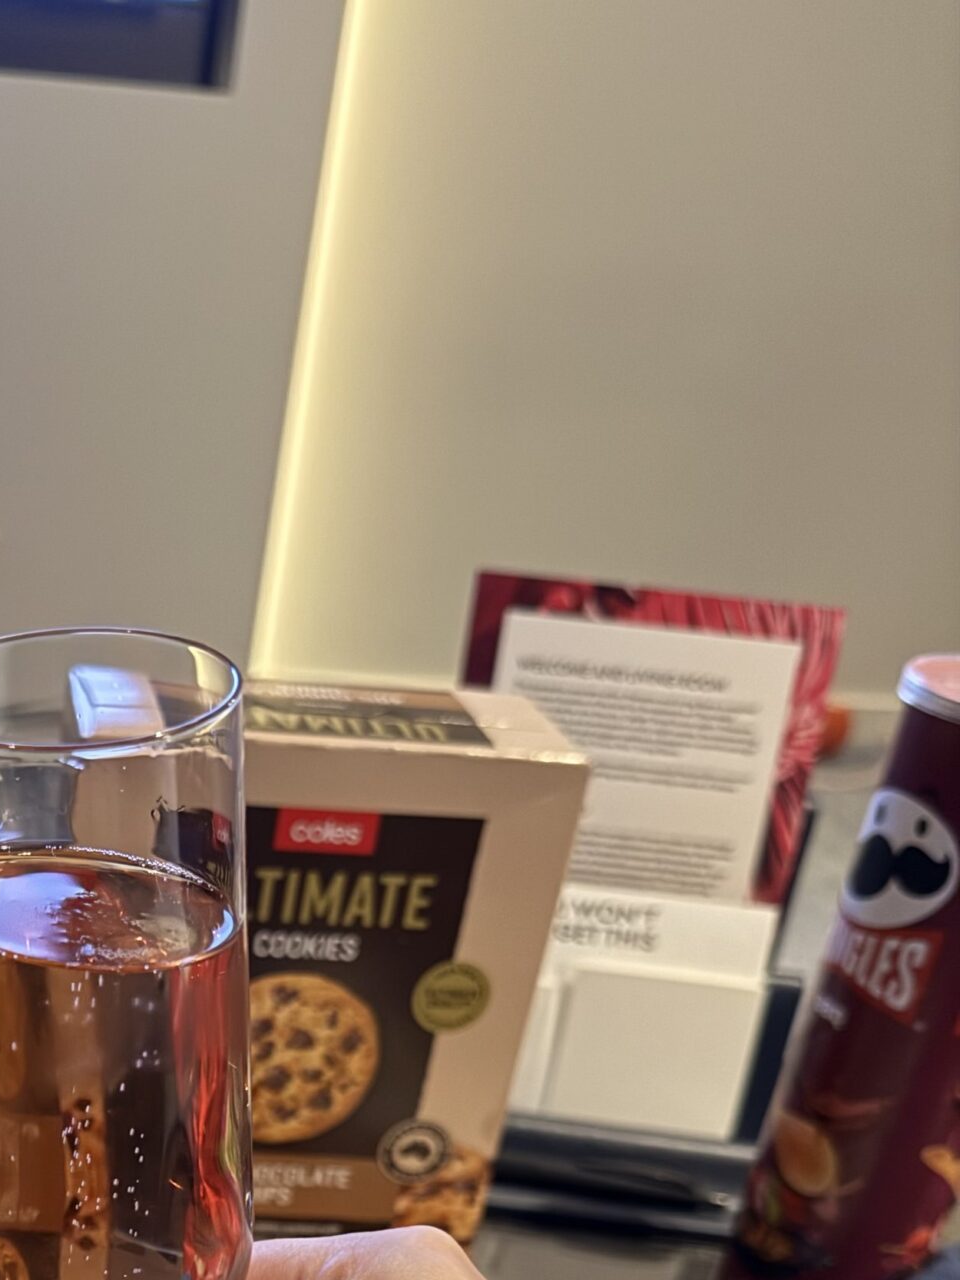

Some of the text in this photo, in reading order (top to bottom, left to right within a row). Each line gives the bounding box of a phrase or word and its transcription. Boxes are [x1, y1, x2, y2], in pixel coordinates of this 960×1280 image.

[290, 820, 365, 846] coles
[247, 866, 440, 931] TIMATE
[252, 930, 361, 962] COOKIES
[832, 929, 930, 1012] GLES
